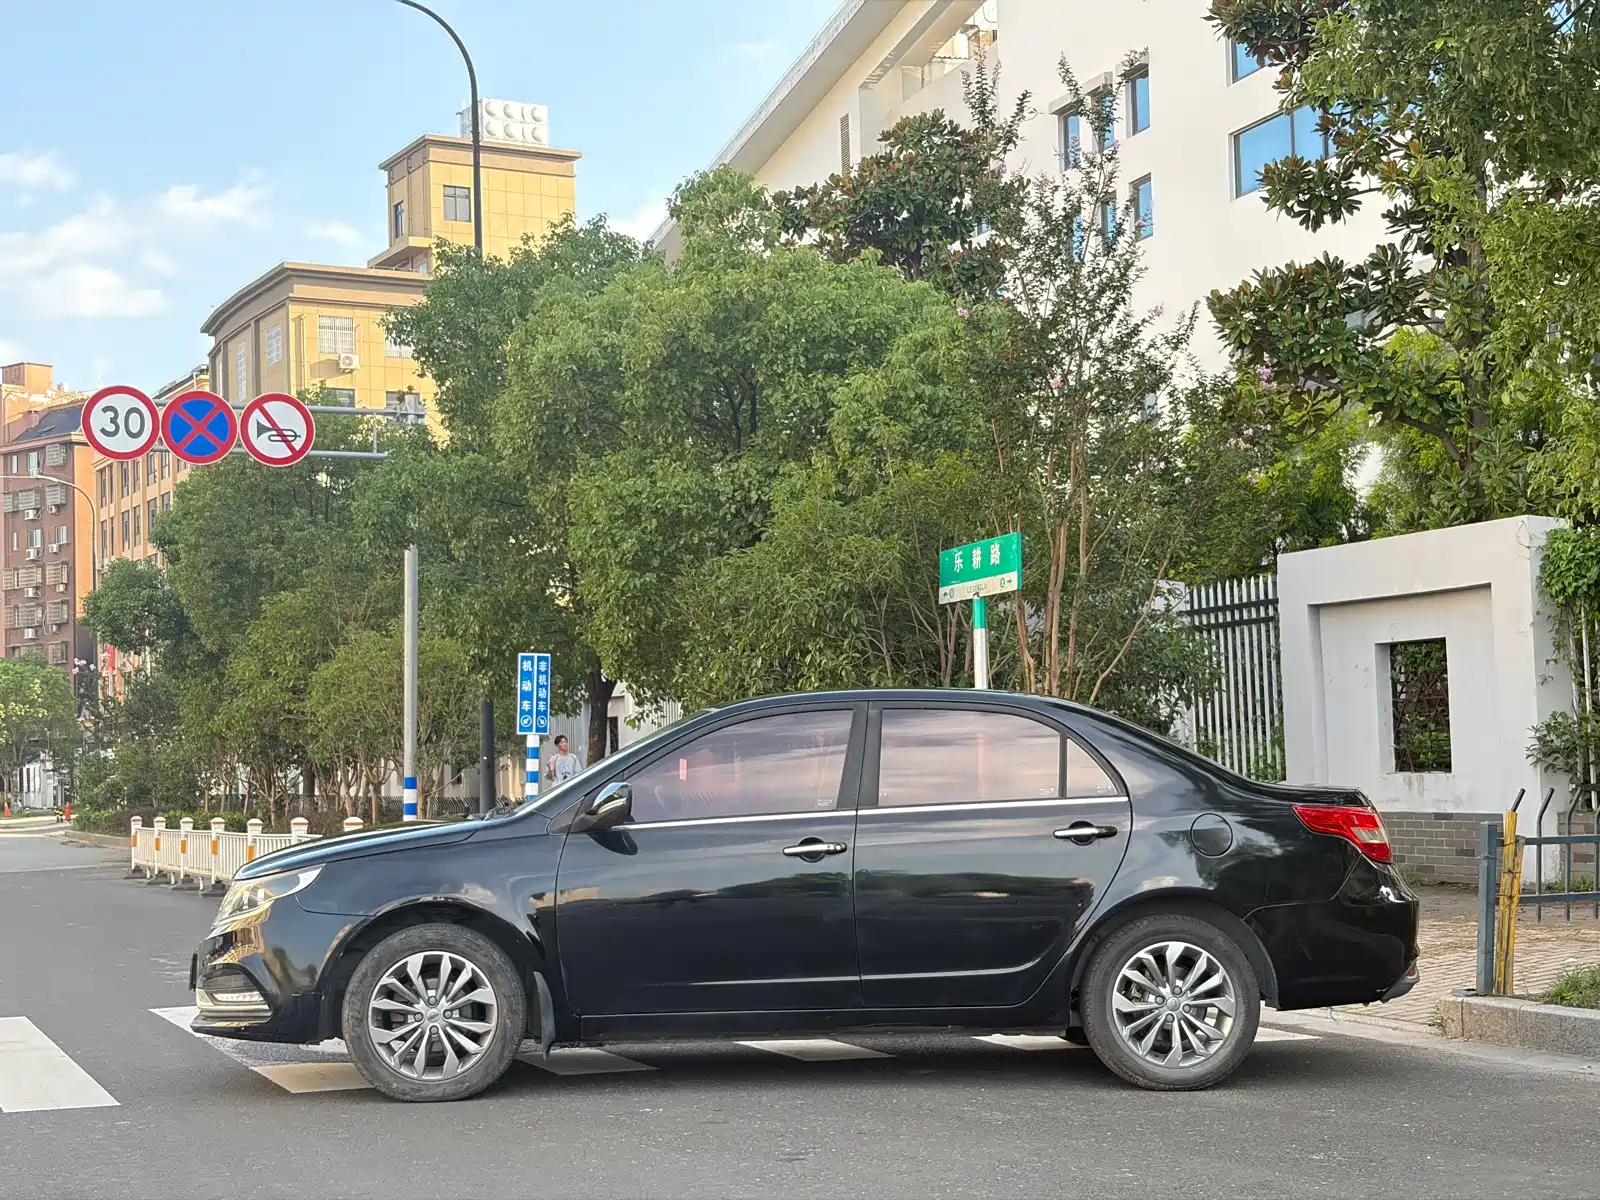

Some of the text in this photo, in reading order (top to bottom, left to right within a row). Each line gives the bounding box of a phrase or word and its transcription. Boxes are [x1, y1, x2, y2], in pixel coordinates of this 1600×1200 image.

[99, 405, 145, 439] 30
[953, 542, 1001, 573] 乐耕路
[521, 660, 532, 712] 机动车
[538, 660, 547, 712] 非机动车
